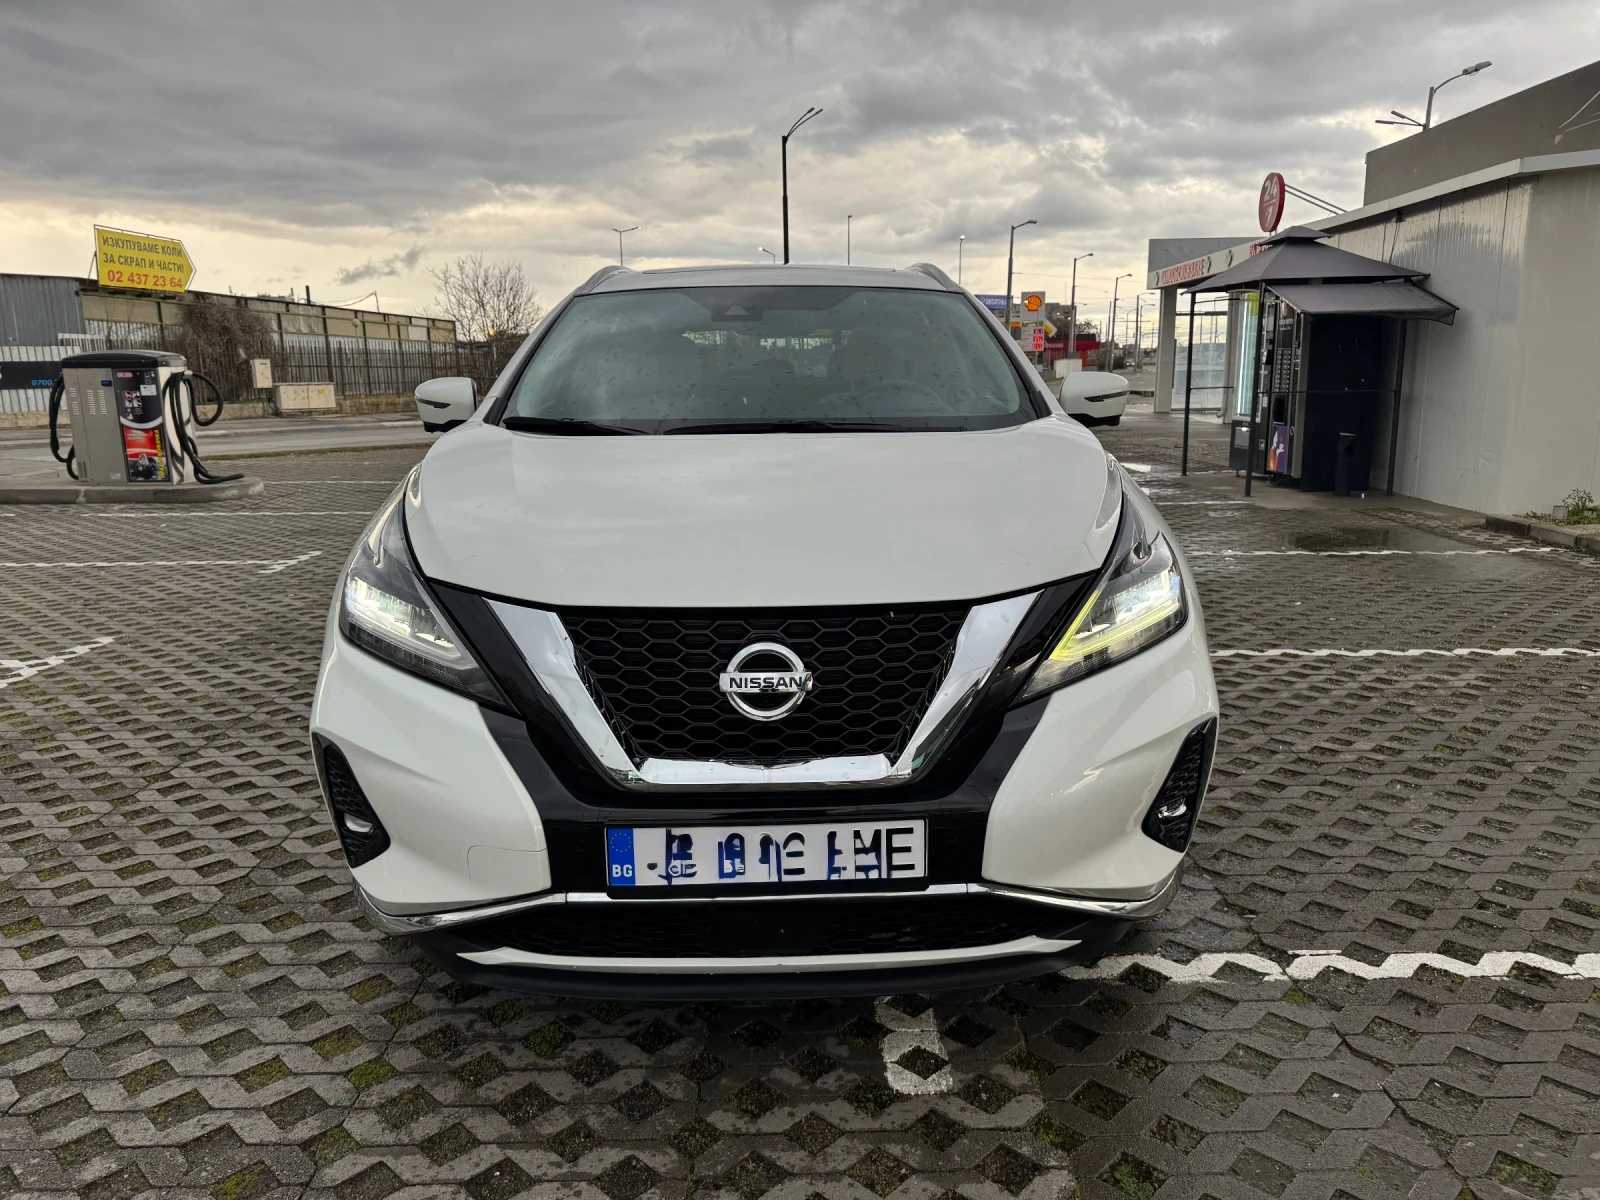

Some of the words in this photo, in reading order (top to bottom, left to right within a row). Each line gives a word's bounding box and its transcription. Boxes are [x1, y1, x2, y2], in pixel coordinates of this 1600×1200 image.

[1263, 175, 1278, 202] 24
[1265, 205, 1274, 228] 7
[102, 235, 160, 254] ИЗКУПУВАМЕ
[161, 245, 183, 258] КОЛИ
[102, 252, 116, 264] ЗА
[117, 254, 147, 268] СКРАП
[148, 259, 154, 269] И
[157, 261, 184, 273] ЧАСТИ!
[107, 269, 123, 283] 02
[127, 272, 149, 285] 437
[152, 275, 167, 287] 23
[169, 277, 182, 288] 64
[729, 676, 803, 689] NISSAN
[612, 863, 633, 878] BG
